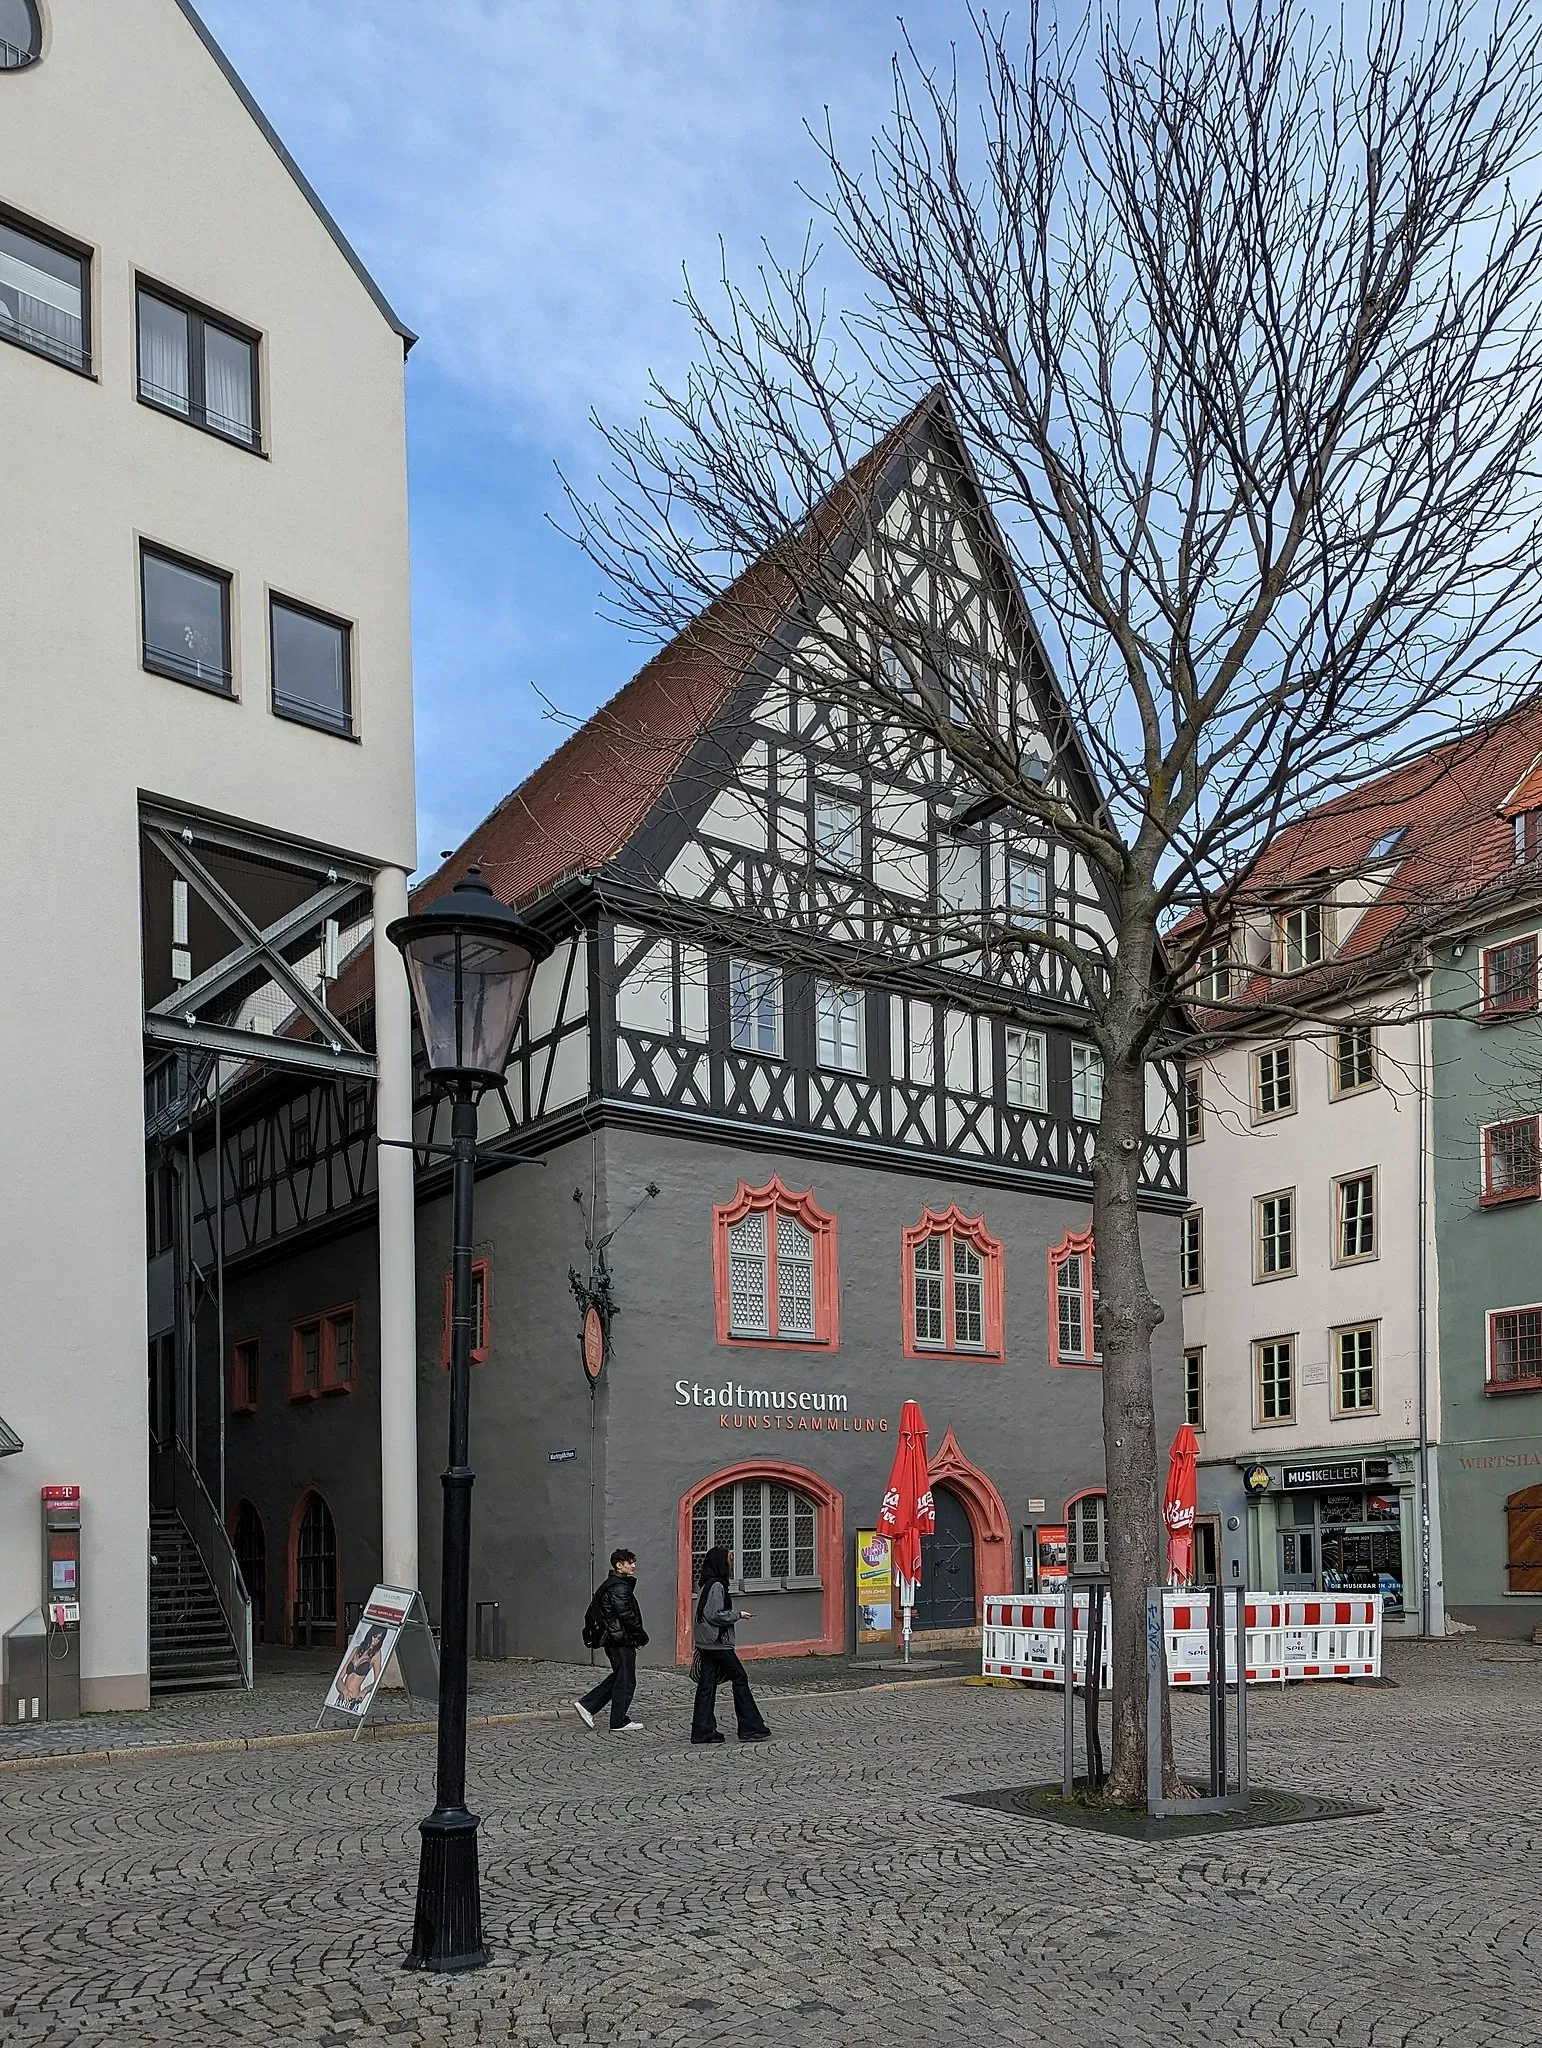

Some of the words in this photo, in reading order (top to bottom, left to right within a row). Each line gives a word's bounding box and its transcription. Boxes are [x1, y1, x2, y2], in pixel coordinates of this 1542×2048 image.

[675, 1379, 848, 1412] Stadtmuseum
[719, 1414, 889, 1433] KUNSTSAMMLUNG
[1460, 1452, 1542, 1470] WIRTSHA
[1288, 1467, 1359, 1483] MUSIKELLER
